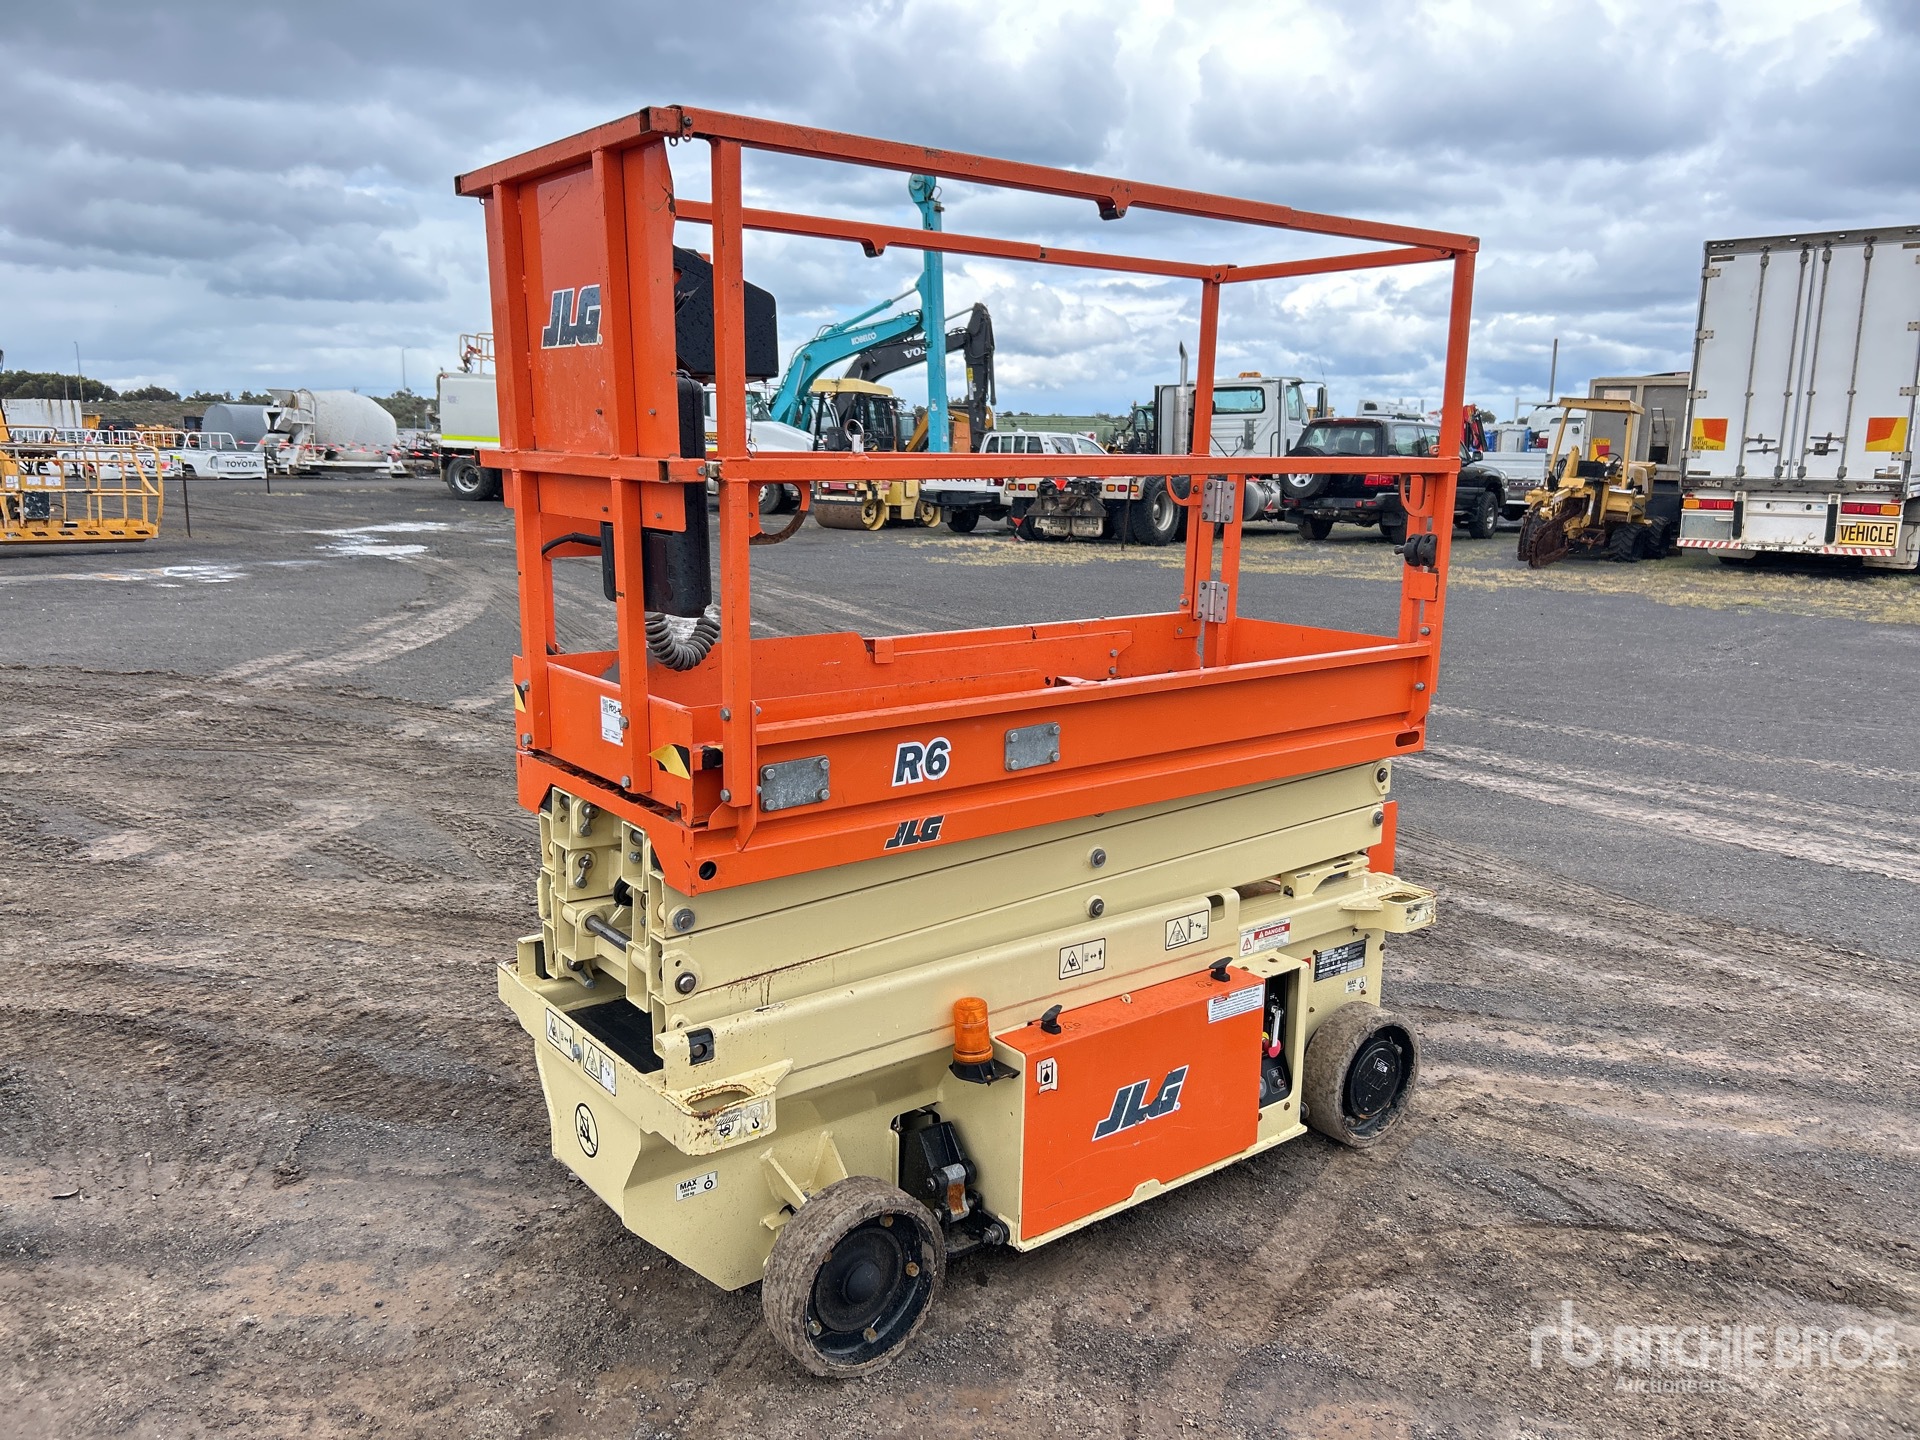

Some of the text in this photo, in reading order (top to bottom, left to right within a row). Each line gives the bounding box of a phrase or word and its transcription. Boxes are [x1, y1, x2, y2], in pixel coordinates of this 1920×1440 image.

[541, 284, 603, 349] JLG
[851, 332, 877, 346] KOBELCO
[226, 459, 258, 468] TOYOTA
[1841, 525, 1895, 543] VEHICLE
[892, 737, 951, 787] R6
[884, 815, 945, 850] JLG
[1264, 925, 1286, 937] DANGER
[1092, 1064, 1189, 1141] JLG
[680, 1179, 697, 1190] MAX
